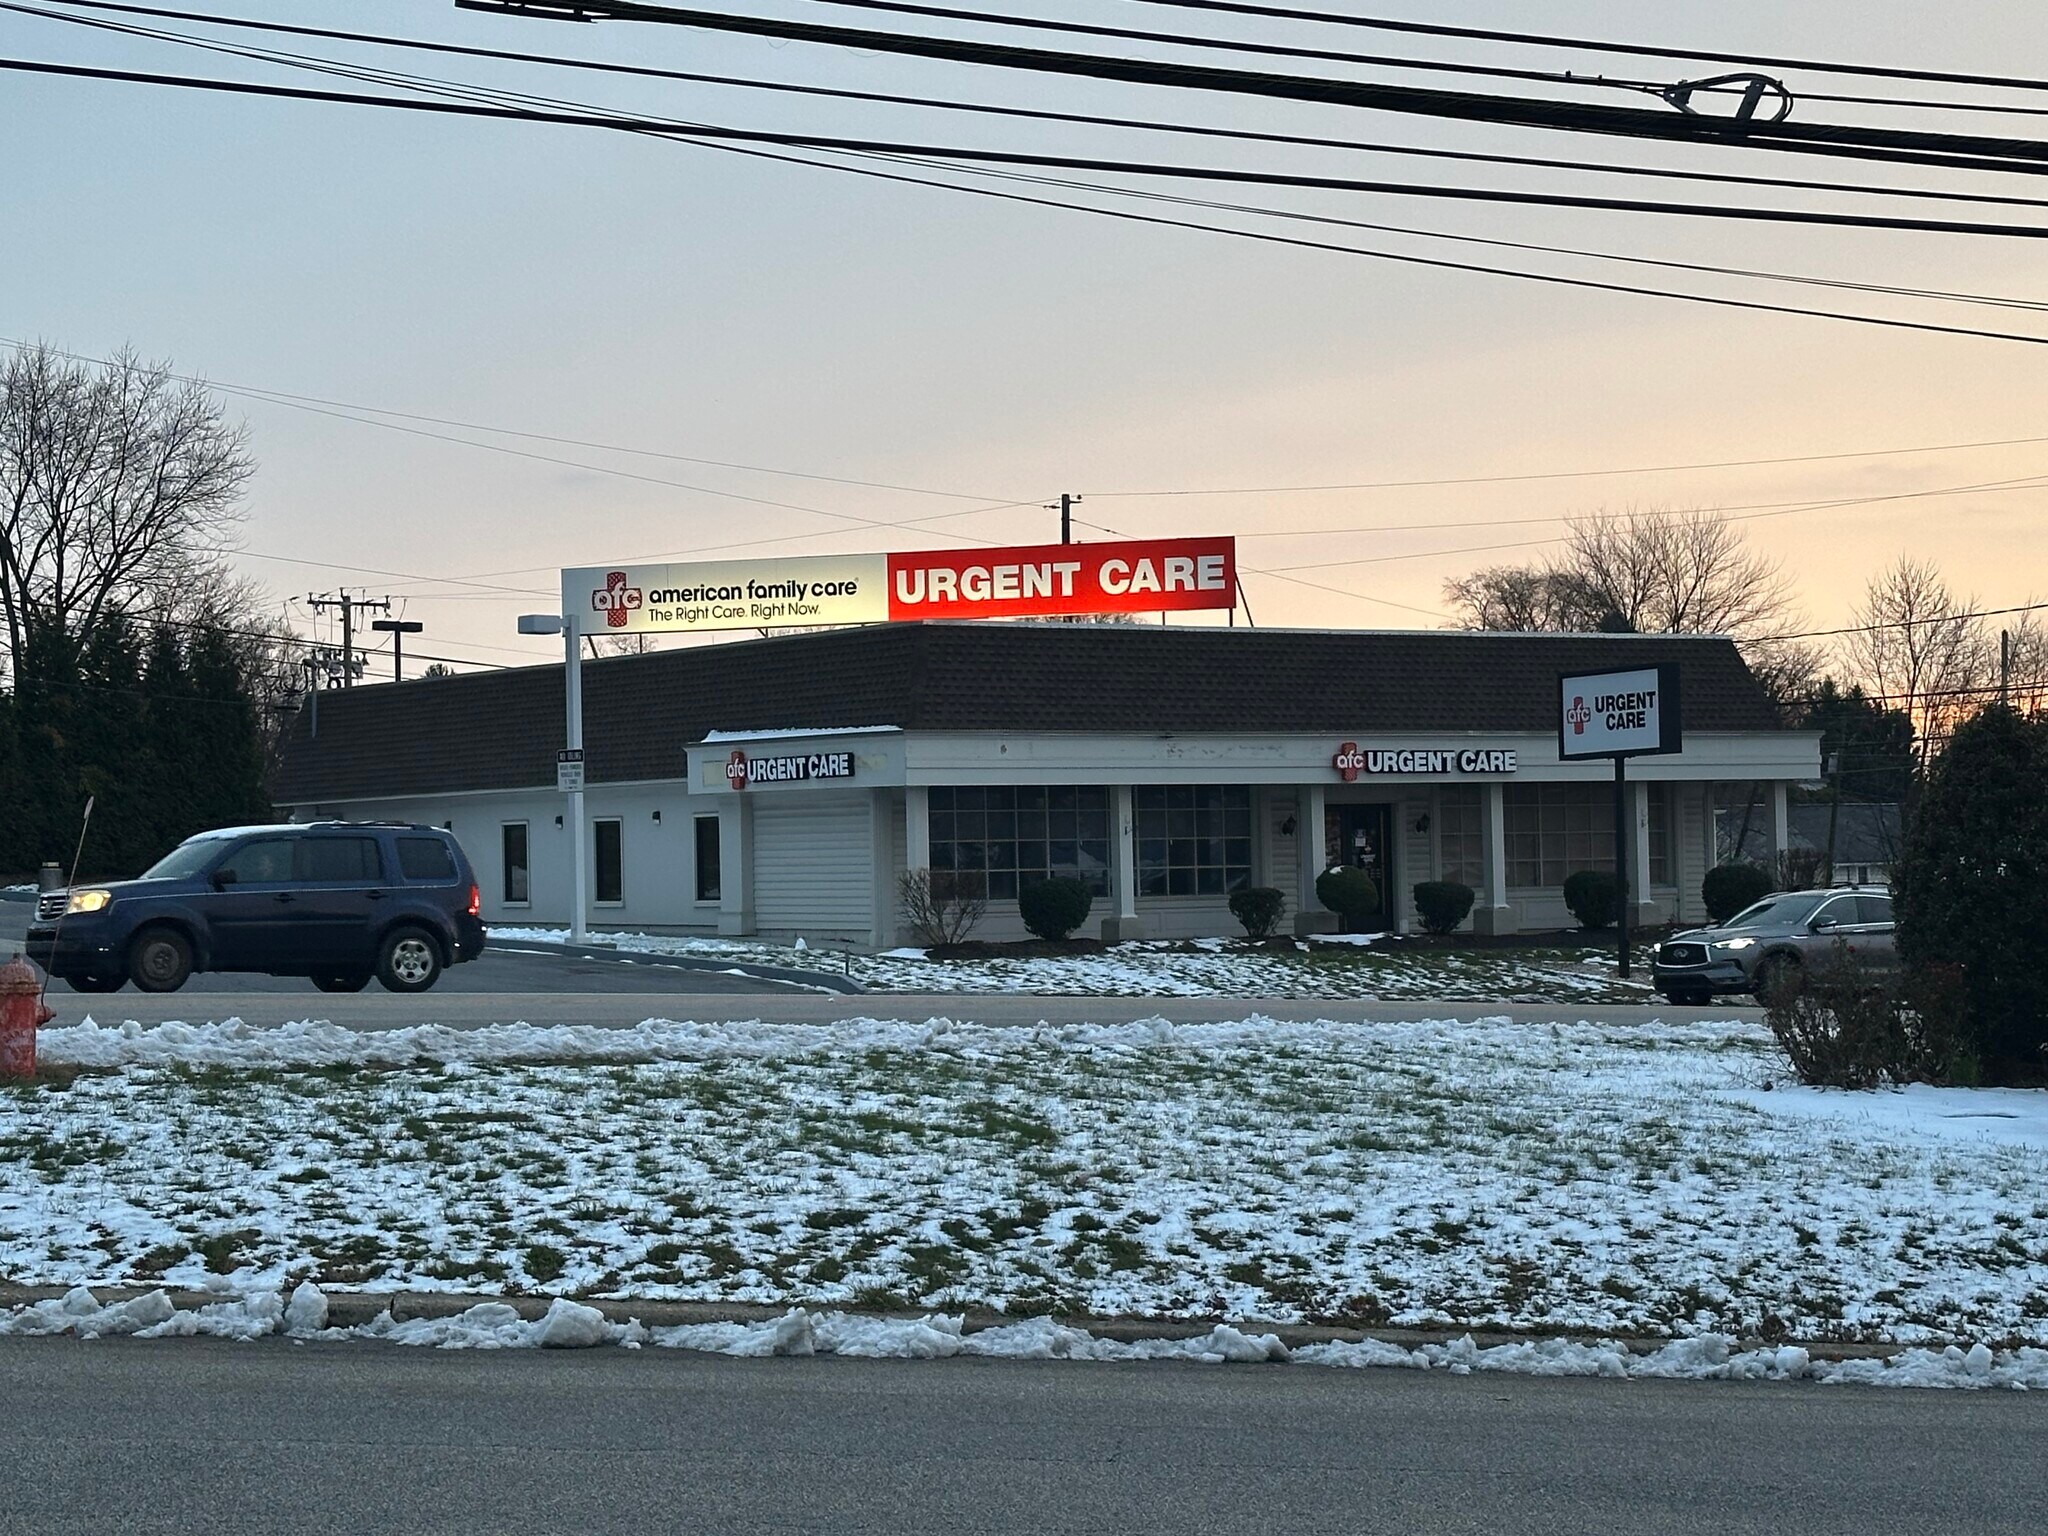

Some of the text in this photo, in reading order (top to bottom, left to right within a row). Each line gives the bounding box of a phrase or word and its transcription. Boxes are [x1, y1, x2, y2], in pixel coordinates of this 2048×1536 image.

[896, 555, 1226, 604] URGENT CARE
[593, 581, 642, 610] afc
[649, 584, 742, 604] american
[746, 579, 808, 602] family
[649, 602, 821, 623] The Right Care. Right Now.
[1567, 703, 1591, 723] afc
[1594, 691, 1656, 713] URGENT
[1606, 711, 1646, 731] CARE
[727, 753, 850, 781] afc URGENT CARE
[1337, 750, 1518, 773] afc URGENT CARE
